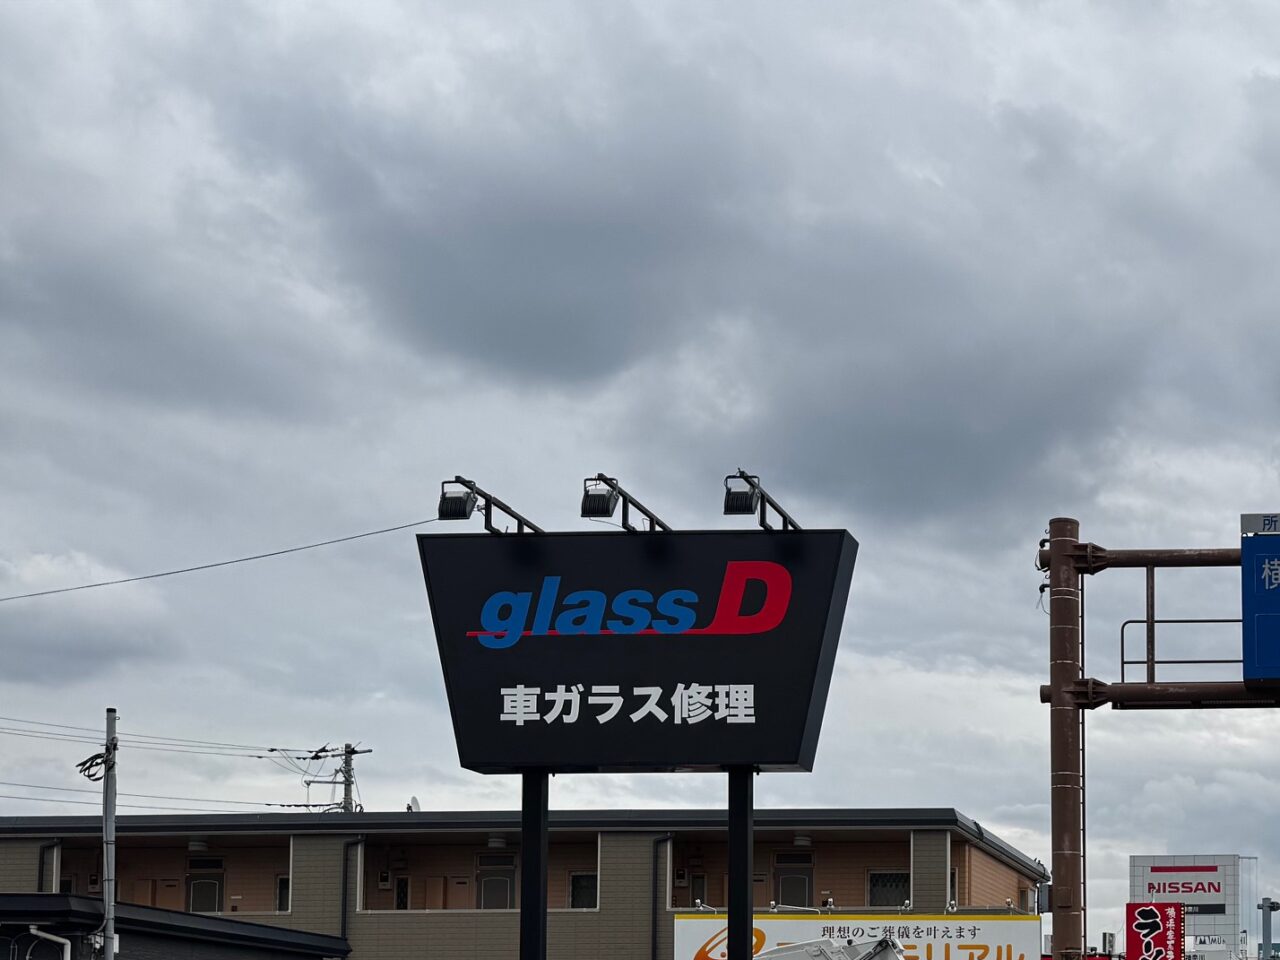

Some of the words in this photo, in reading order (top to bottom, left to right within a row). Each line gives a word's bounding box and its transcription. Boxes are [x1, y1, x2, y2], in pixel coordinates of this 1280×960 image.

[500, 683, 756, 726] 車ガラス修理
[1147, 881, 1221, 894] NISSAN
[821, 925, 982, 939] 理想のご葬儀を叶えます
